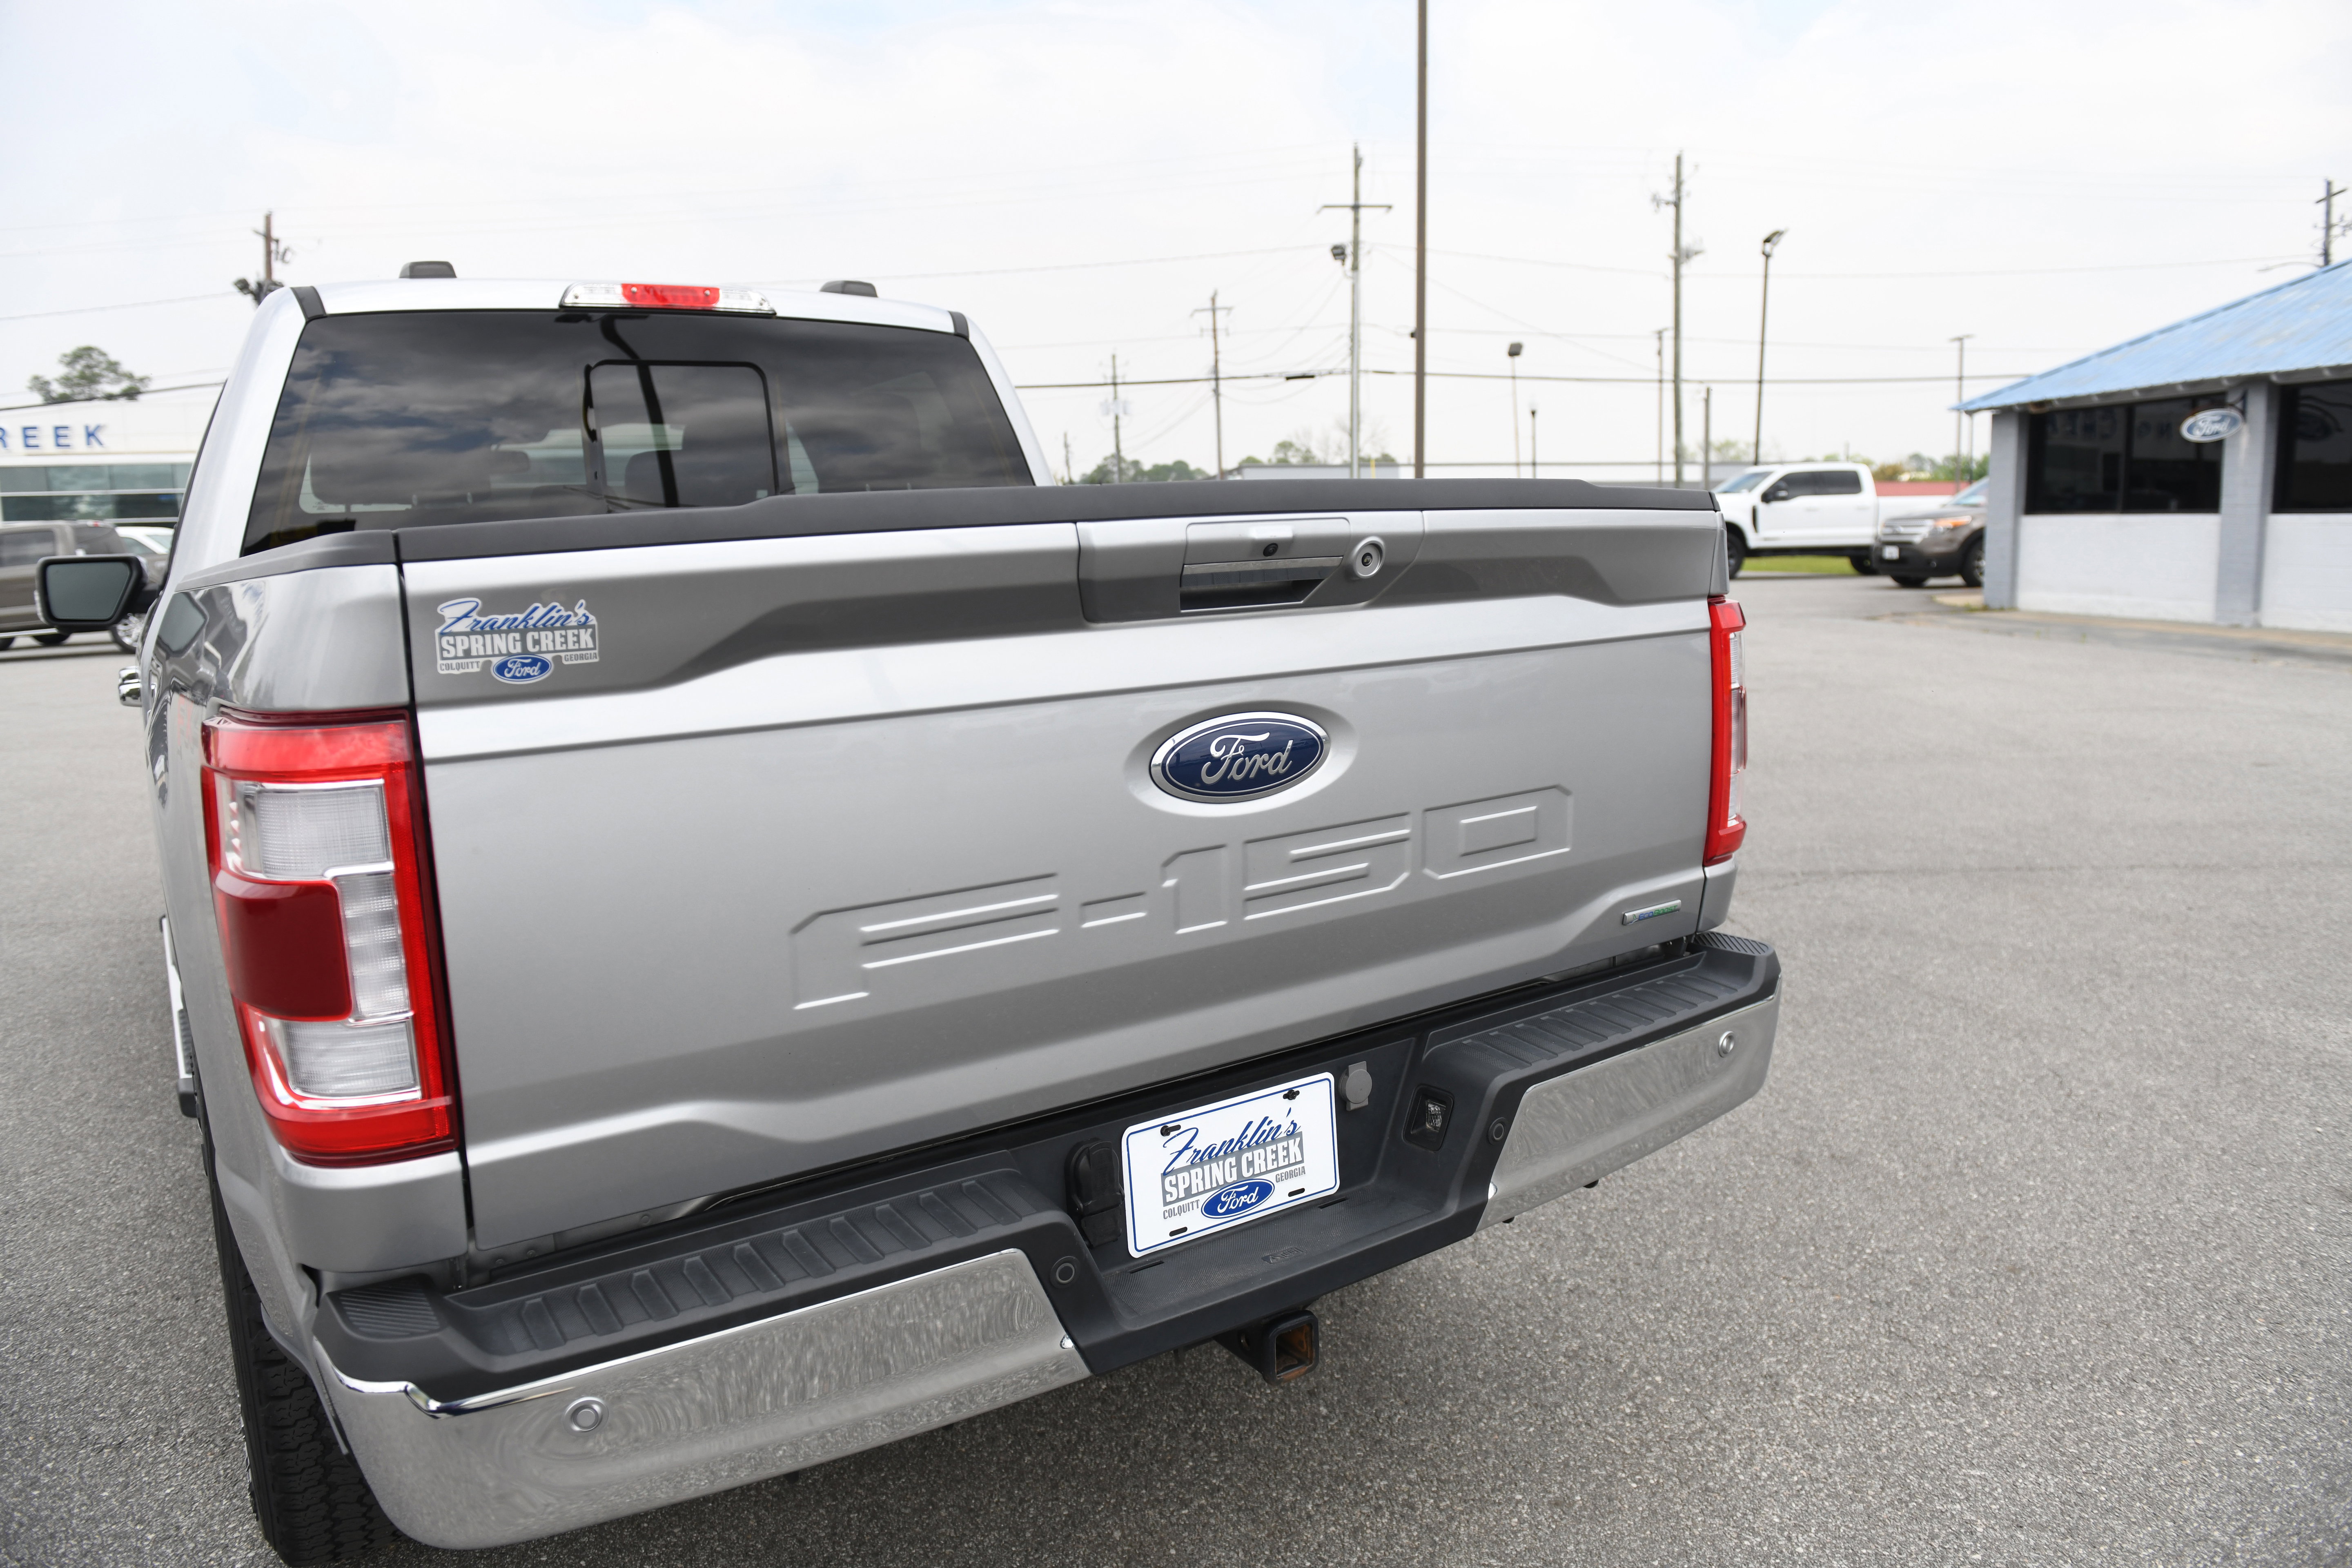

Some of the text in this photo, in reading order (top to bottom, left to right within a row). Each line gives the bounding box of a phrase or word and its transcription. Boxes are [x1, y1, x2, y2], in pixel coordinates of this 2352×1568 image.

[2193, 415, 2231, 437] Ford
[440, 600, 593, 635] Franklin's
[441, 628, 594, 658] SPRING CREEK
[439, 660, 480, 671] COLQUITT
[504, 658, 541, 677] Ford
[564, 653, 598, 662] GEORGIA
[1201, 732, 1293, 785] Ford
[789, 784, 1574, 1010] F-150
[1163, 1107, 1301, 1176] Franklin's
[1165, 1137, 1303, 1203] SPRING CREEK
[1275, 1166, 1306, 1183] GEORGIA
[1163, 1199, 1200, 1220] COLQUITT
[1217, 1185, 1259, 1213] Ford
